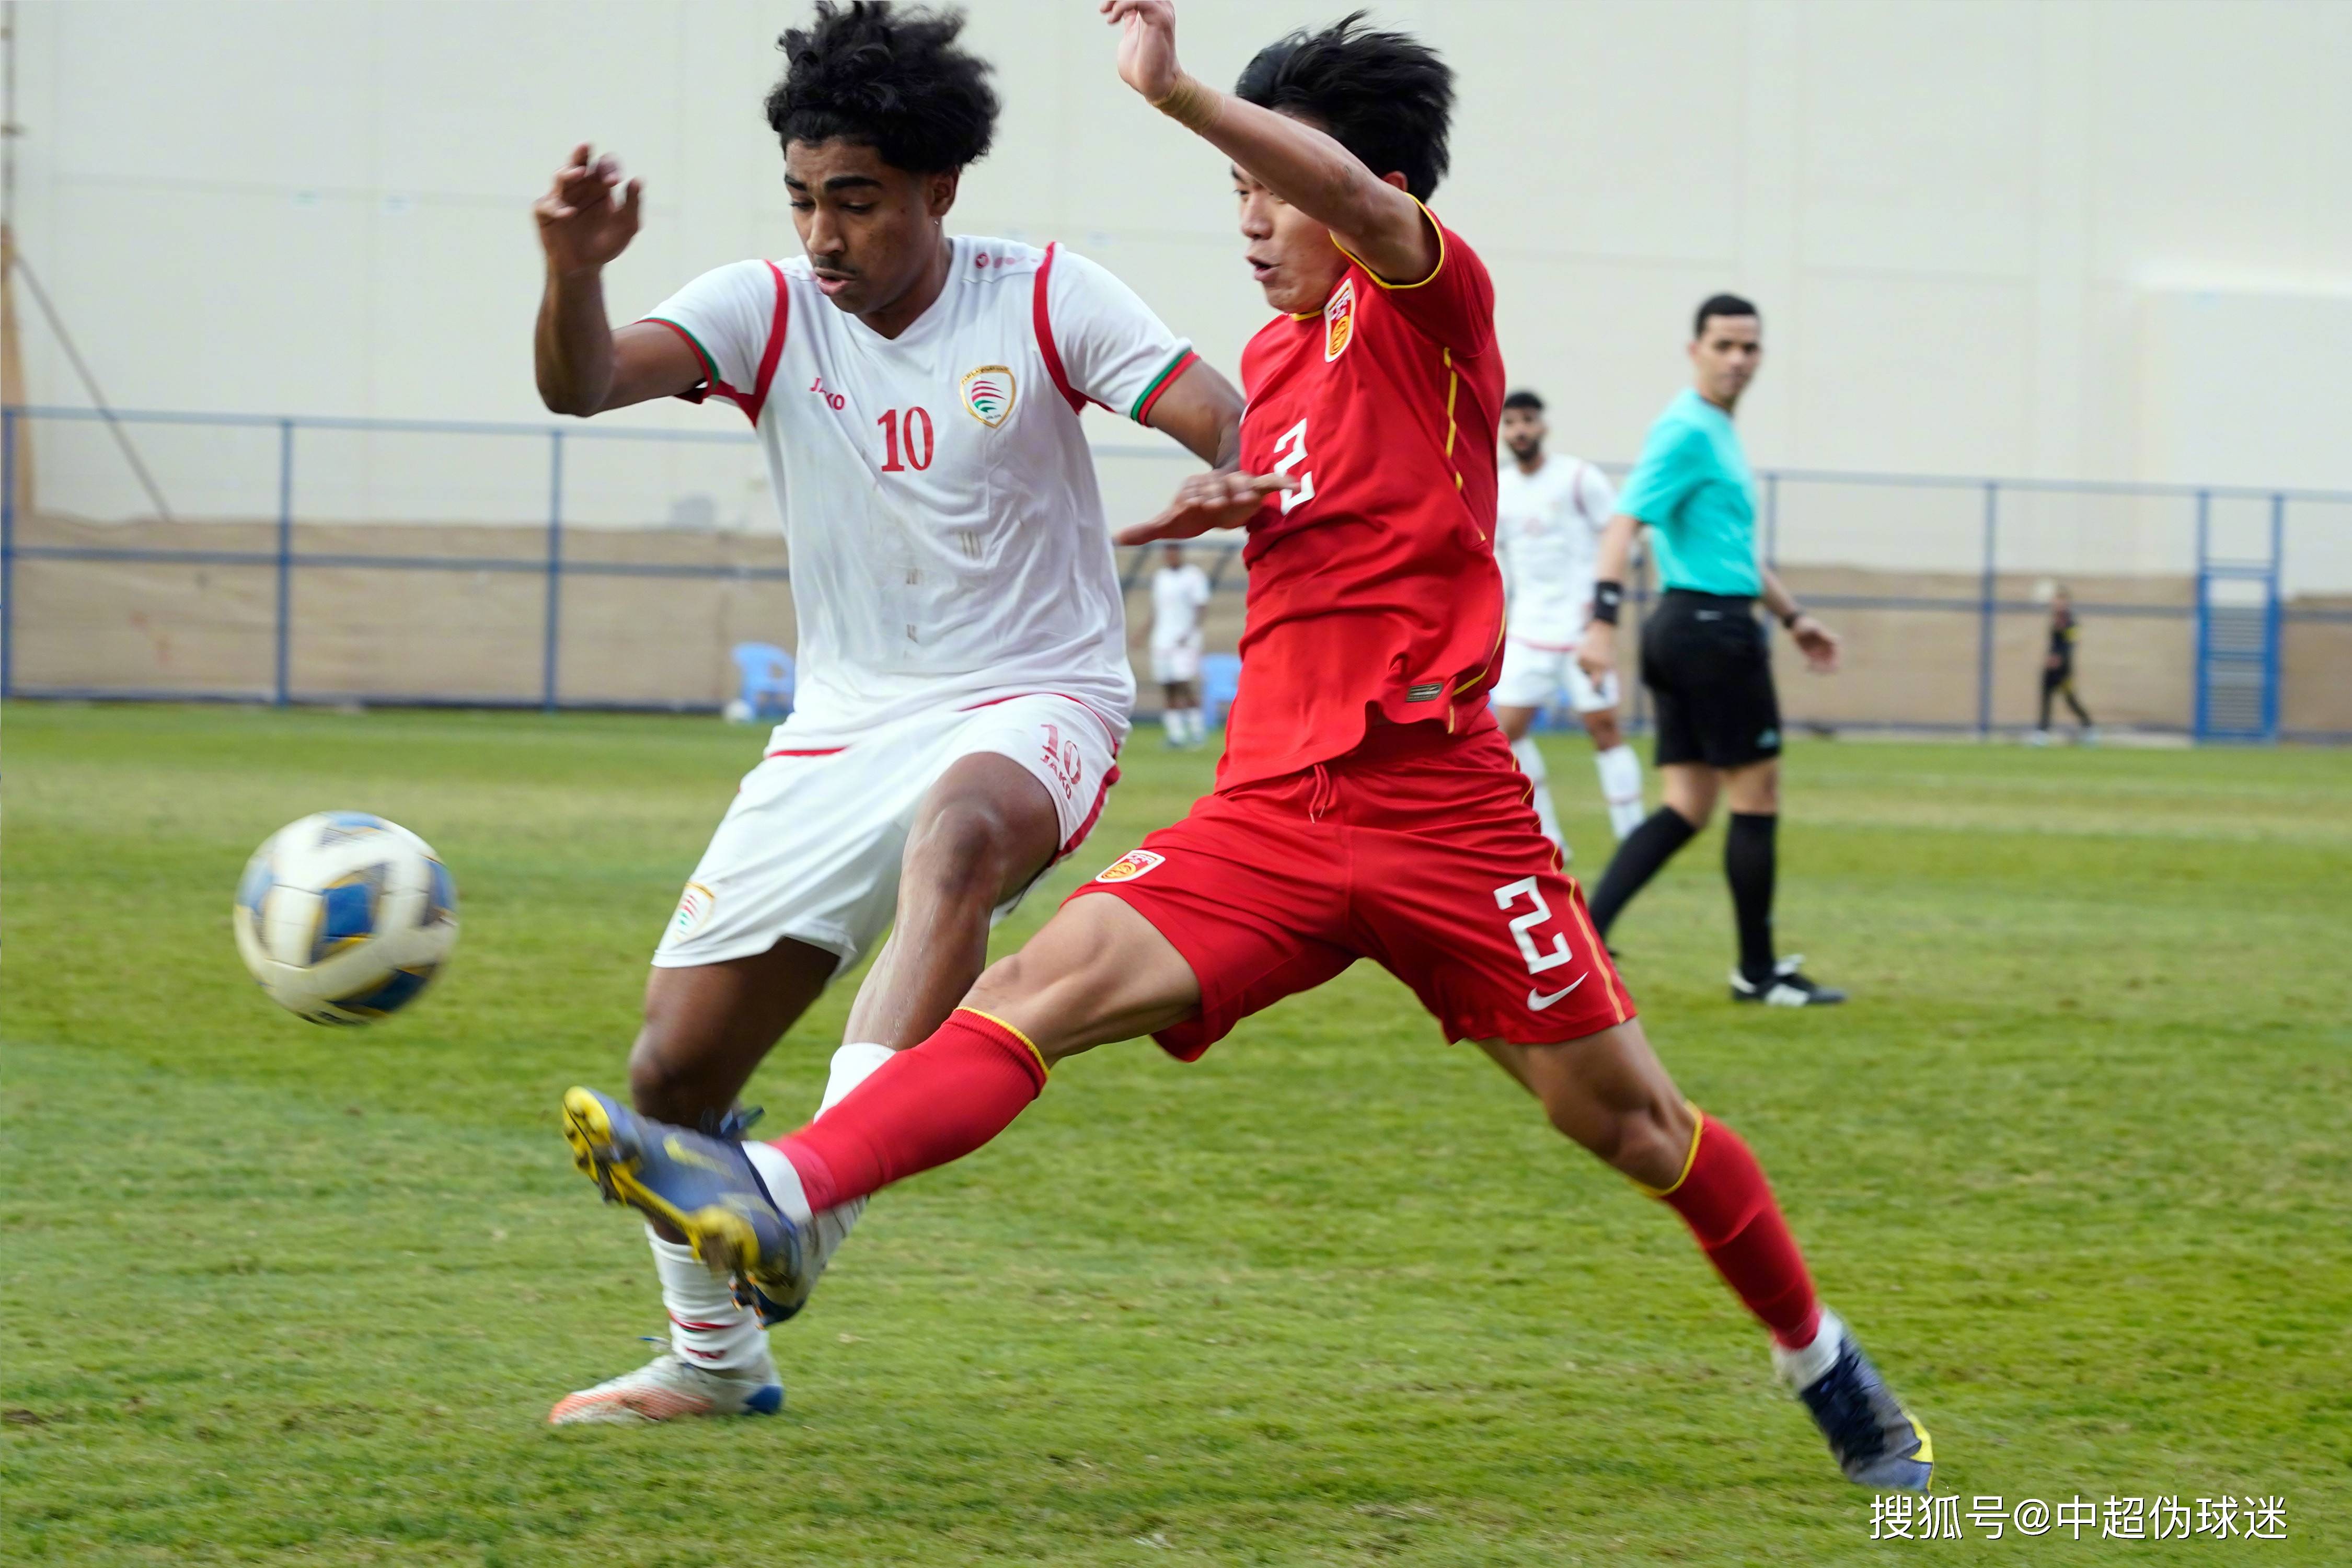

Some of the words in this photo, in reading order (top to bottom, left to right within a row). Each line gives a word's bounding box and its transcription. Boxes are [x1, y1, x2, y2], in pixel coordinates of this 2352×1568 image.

[878, 406, 934, 472] 10
[1273, 417, 1316, 516] 2
[1041, 724, 1081, 785] 10
[1493, 875, 1573, 975] 2
